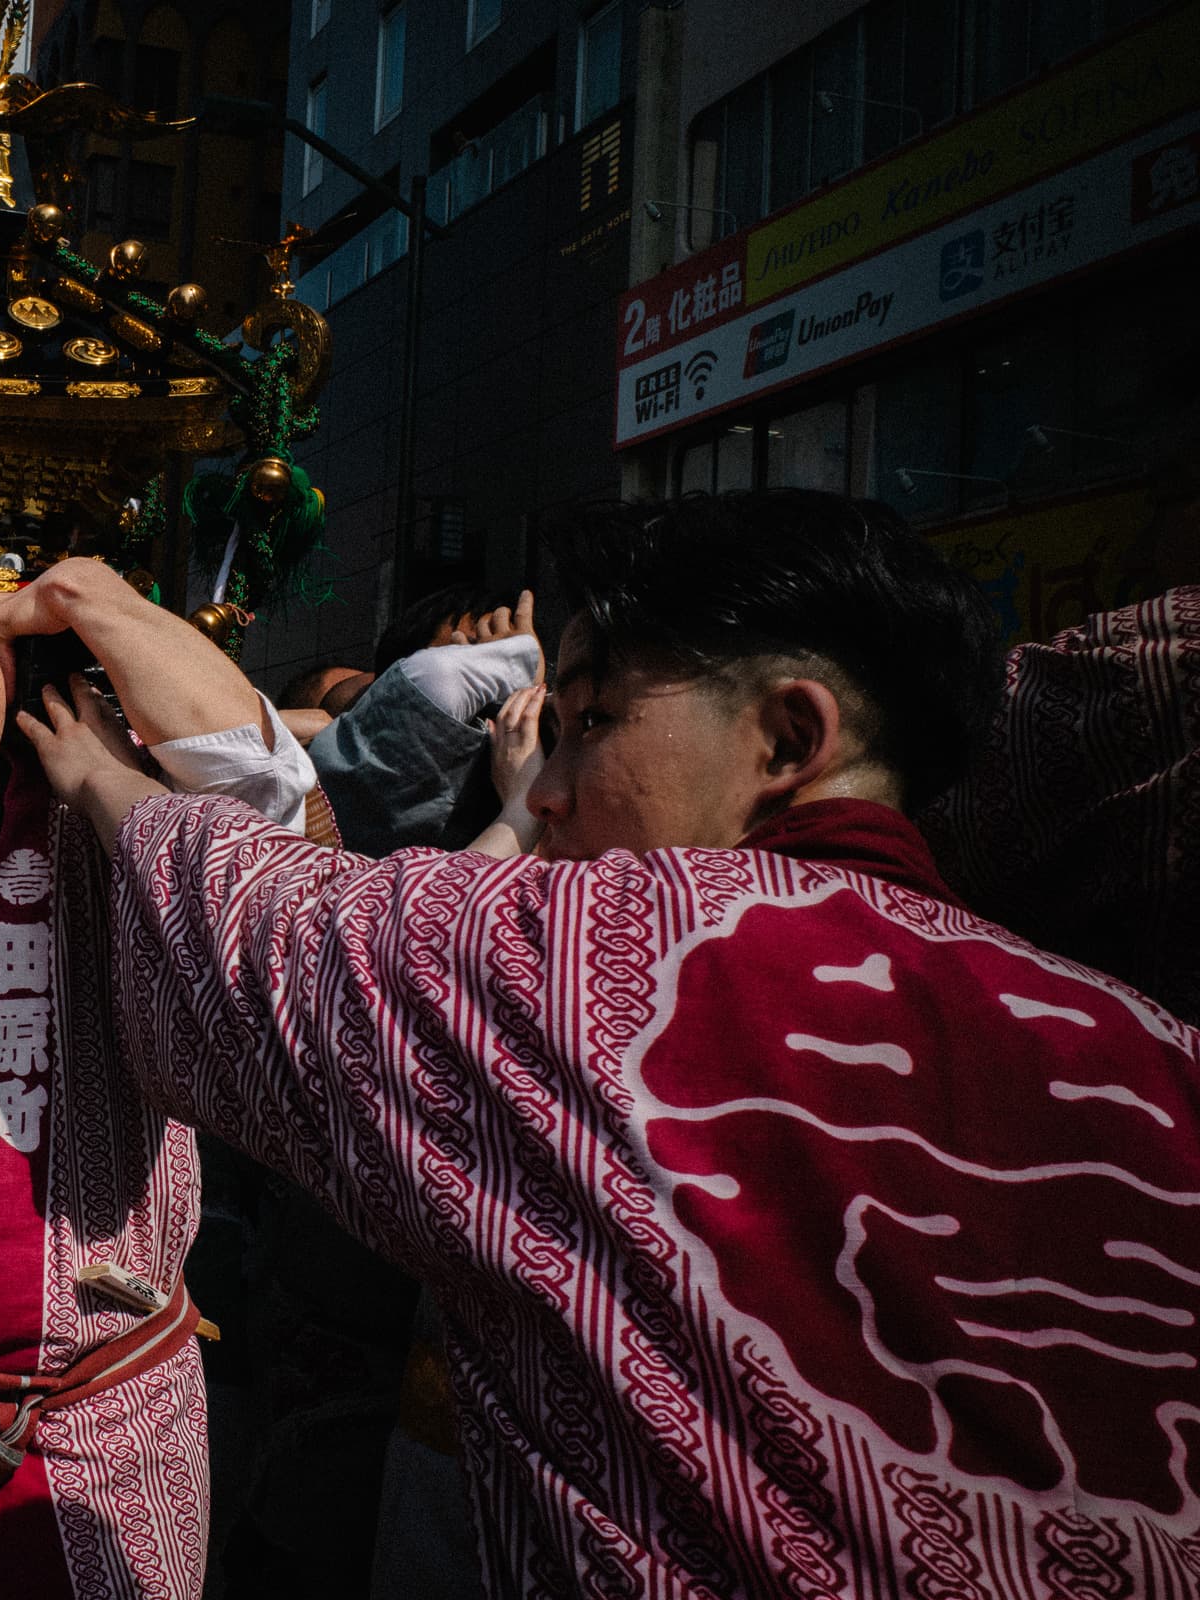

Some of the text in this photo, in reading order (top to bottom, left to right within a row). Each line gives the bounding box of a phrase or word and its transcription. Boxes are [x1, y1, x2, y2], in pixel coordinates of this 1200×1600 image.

[756, 212, 861, 281] SHISEIDO
[881, 146, 995, 222] Kanebo
[993, 194, 1074, 260] 支付宝
[994, 233, 1072, 281] ALIPAY
[668, 262, 742, 335] 化粧品
[798, 291, 895, 346] UnionPay
[636, 386, 680, 425] Wi-Fi
[637, 363, 680, 401] FREE
